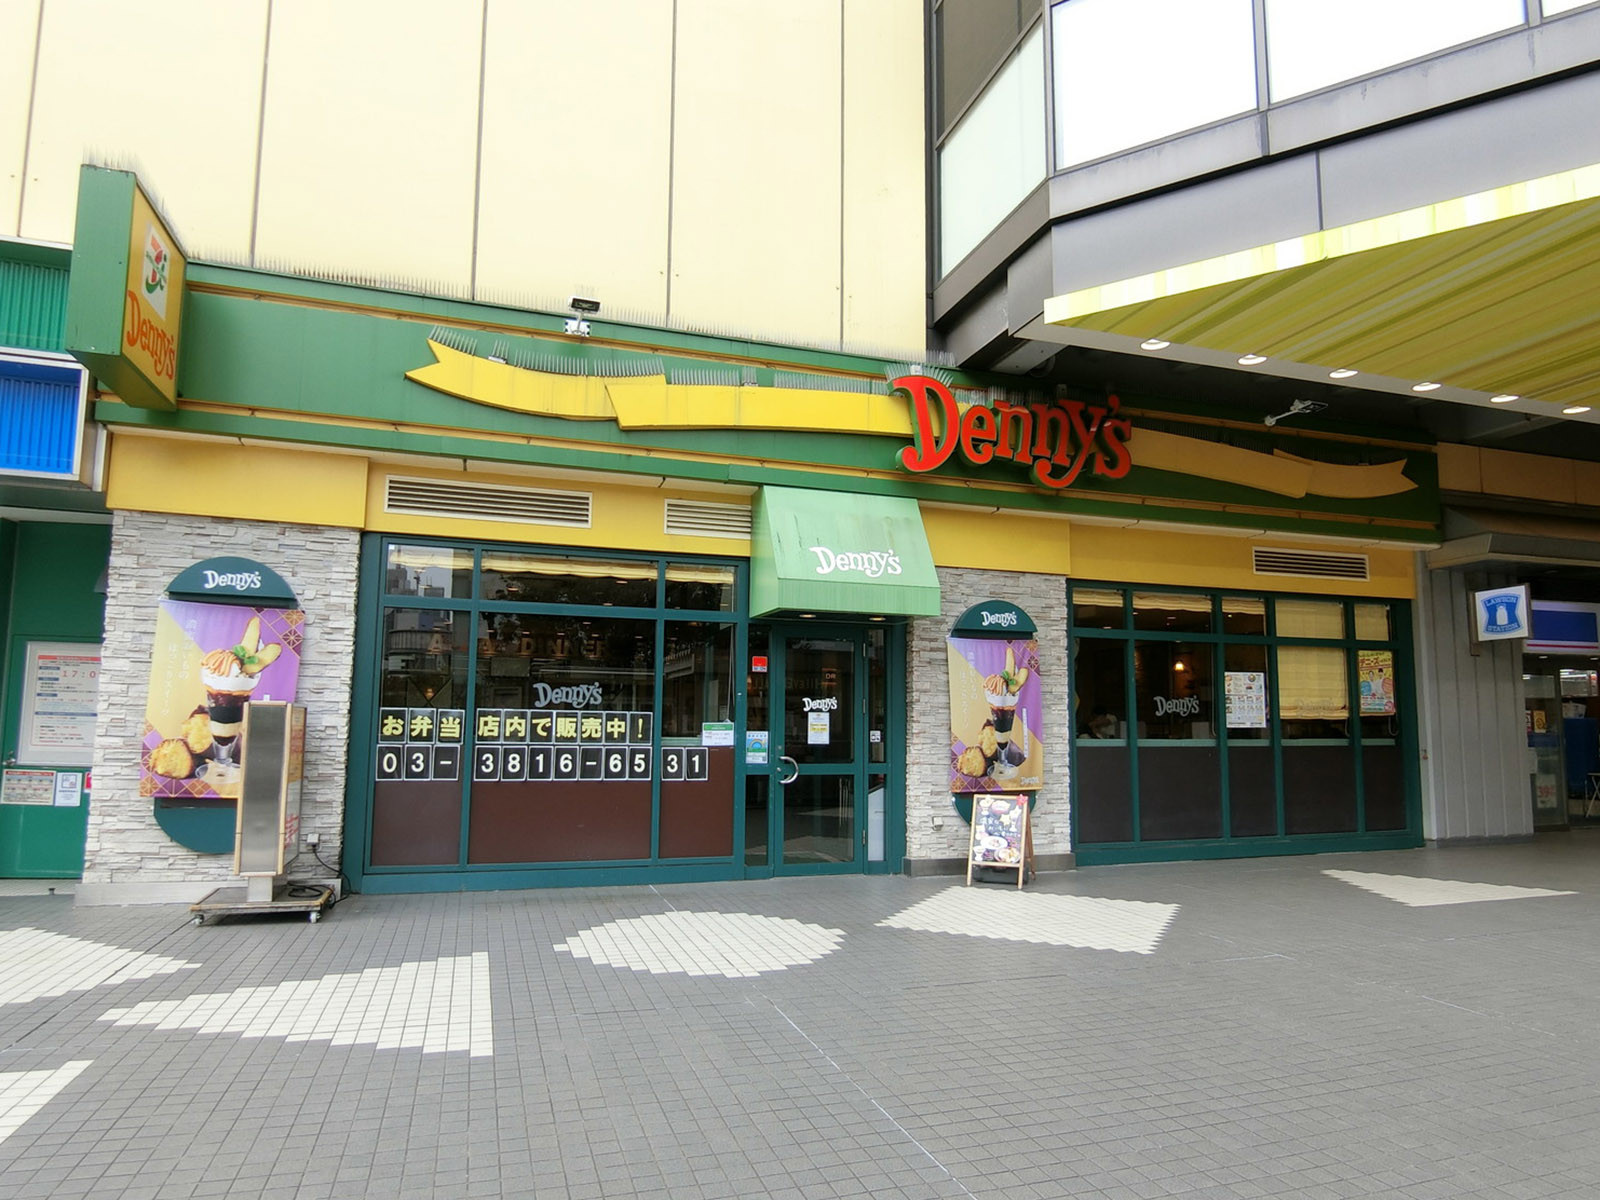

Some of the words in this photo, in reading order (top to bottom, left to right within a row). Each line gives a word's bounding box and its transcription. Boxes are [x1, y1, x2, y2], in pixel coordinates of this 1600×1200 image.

[126, 289, 176, 380] Denny's
[889, 375, 1132, 488] Denny's
[808, 546, 903, 578] Denny's
[203, 570, 262, 591] Denny's
[981, 611, 1017, 627] Denny's
[532, 681, 603, 709] Denny's
[802, 696, 838, 712] Denny's
[1153, 694, 1200, 717] Denny's
